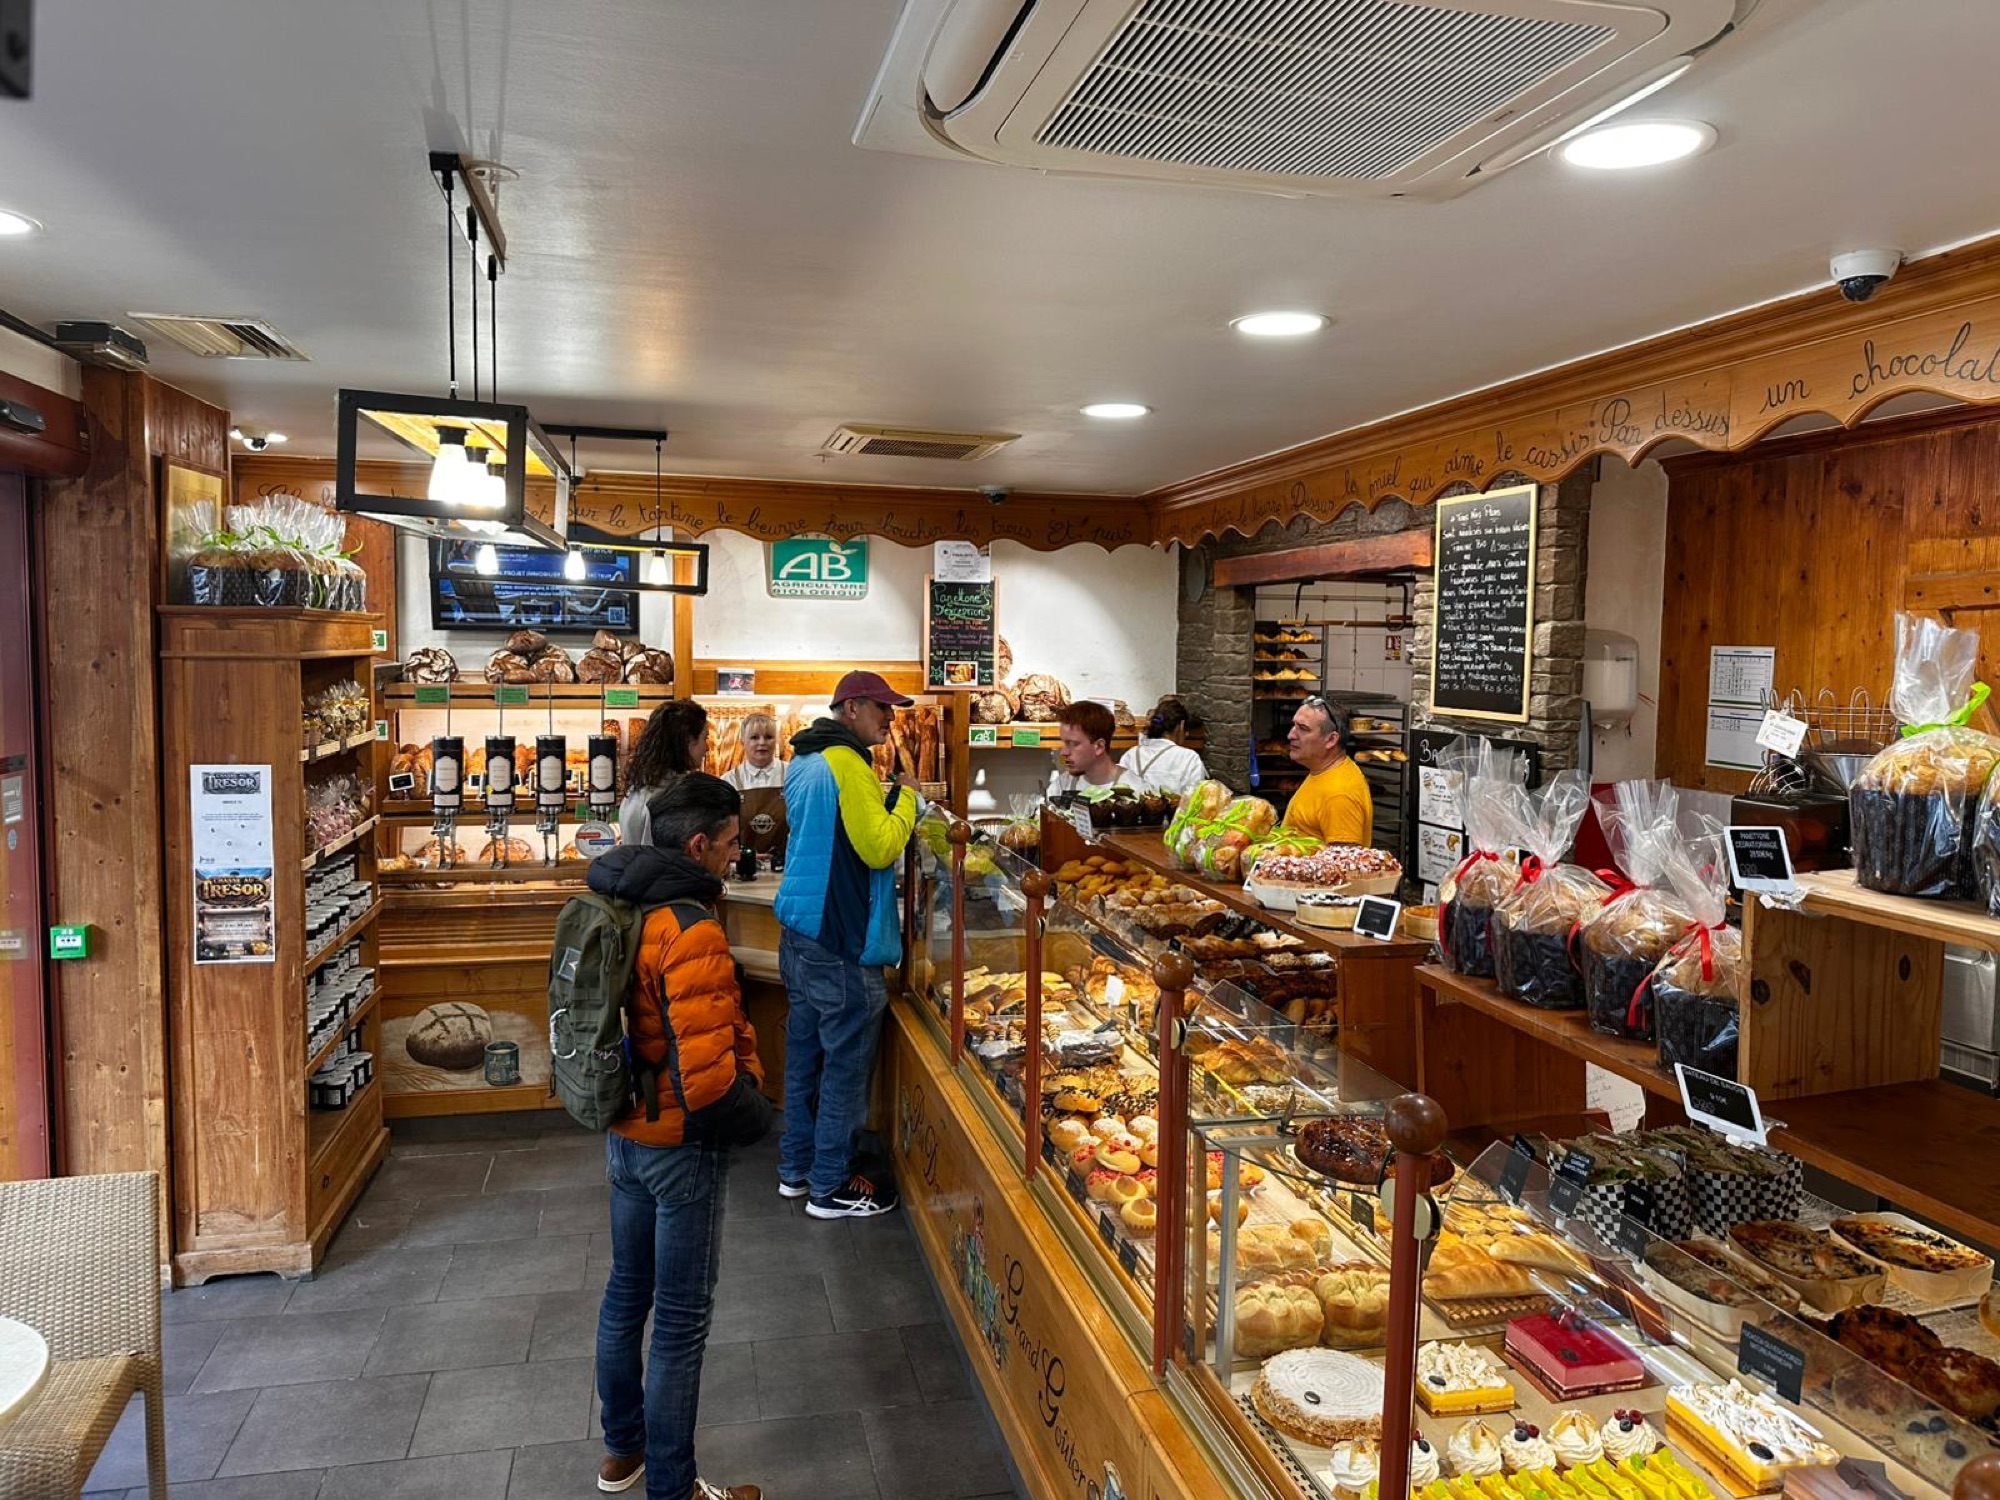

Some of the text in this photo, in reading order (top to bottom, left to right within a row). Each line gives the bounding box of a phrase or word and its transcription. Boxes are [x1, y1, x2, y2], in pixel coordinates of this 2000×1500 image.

[1369, 456, 1401, 497] miel
[1410, 469, 1436, 501] qui
[1442, 449, 1484, 478] aime
[1492, 430, 1514, 466] le
[1522, 432, 1590, 469] cassis
[1600, 398, 1645, 445] Par
[1651, 389, 1730, 437] dessus
[1760, 379, 1811, 416] un
[604, 504, 630, 529] la
[717, 502, 734, 524] le
[742, 507, 808, 536] beurre
[952, 509, 981, 539] les
[779, 552, 852, 580] AB
[772, 580, 867, 590] AGRICULTURE
[772, 588, 866, 597] BIOLOGIQUE
[208, 776, 257, 790] TRESOR
[201, 880, 265, 899] TRESOR
[1001, 1253, 1087, 1489] Grand Goûter
